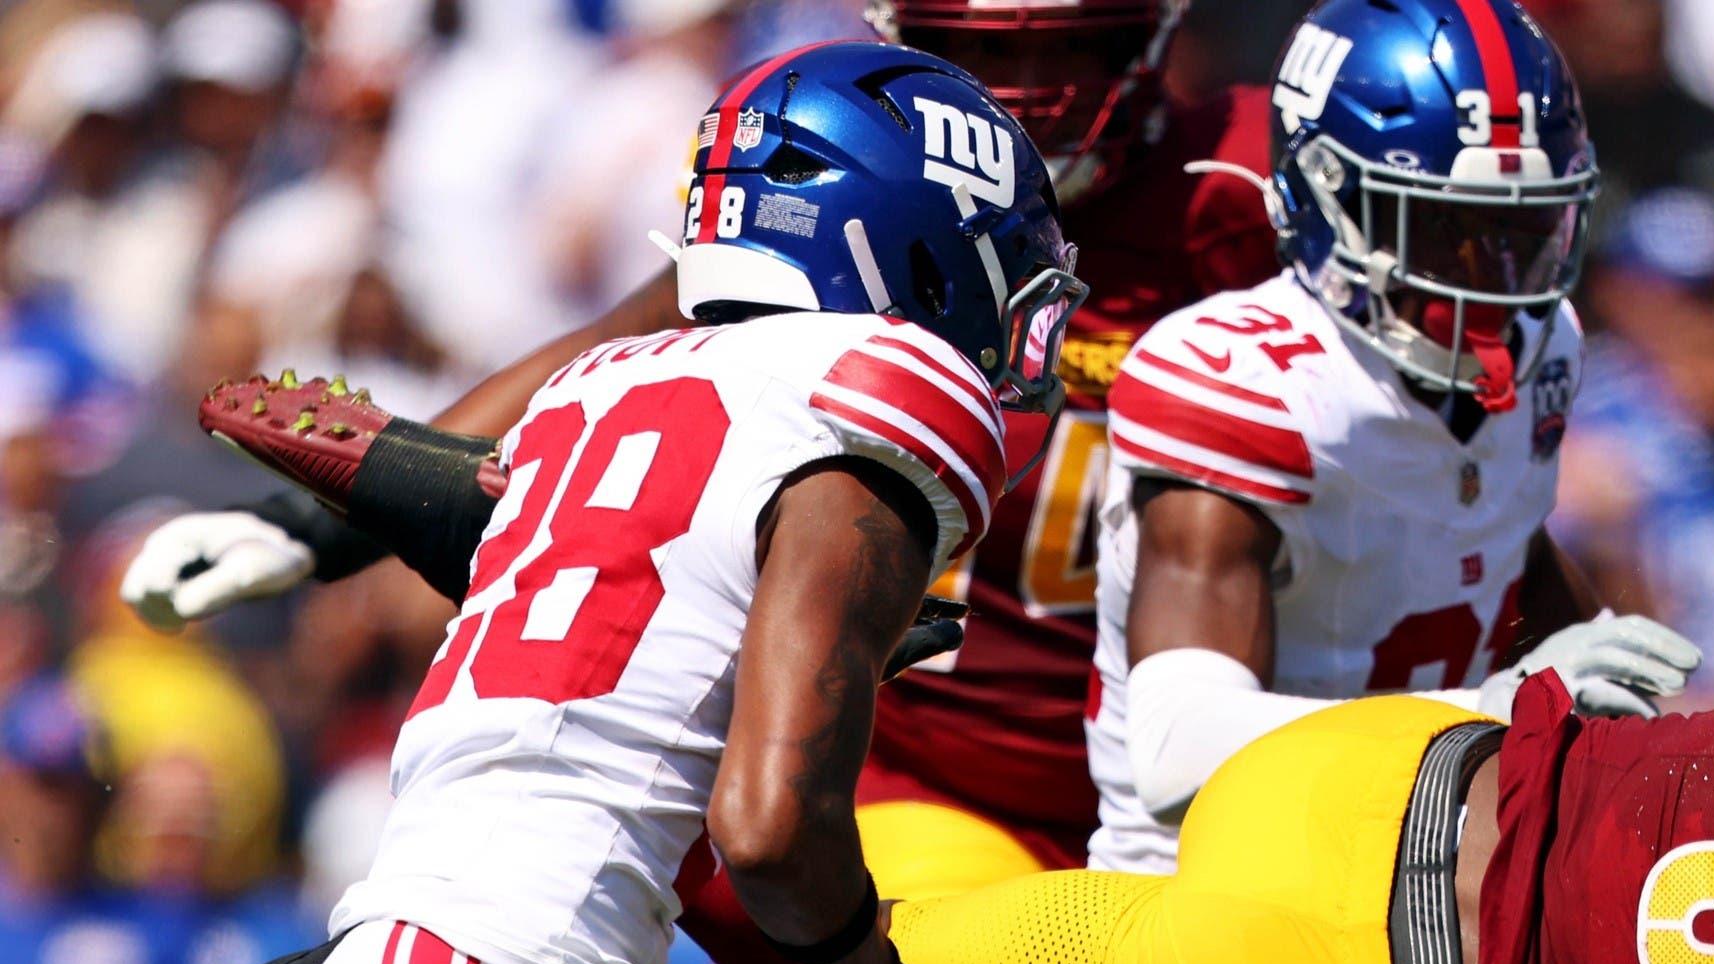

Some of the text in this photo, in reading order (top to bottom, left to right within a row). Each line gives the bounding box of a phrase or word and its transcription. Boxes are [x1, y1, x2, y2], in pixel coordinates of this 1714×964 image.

[1456, 89, 1539, 147] 31
[686, 186, 745, 239] 28
[1195, 304, 1326, 372] 31
[403, 376, 731, 722] 28
